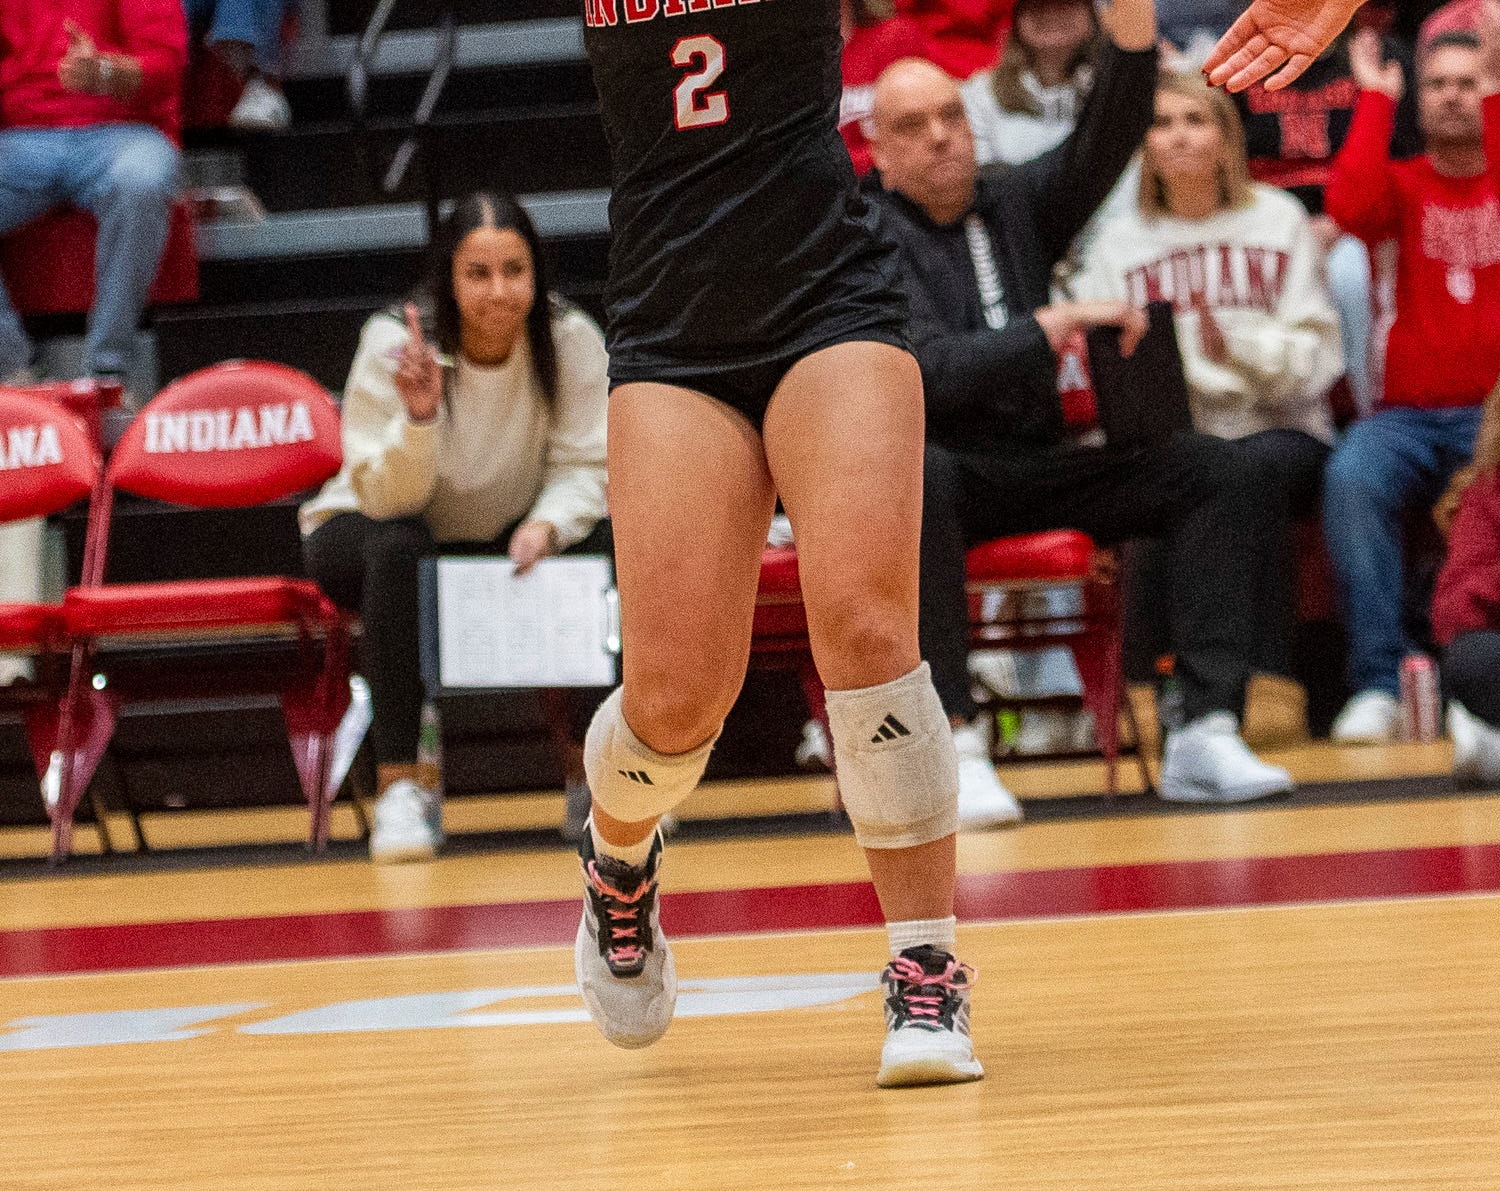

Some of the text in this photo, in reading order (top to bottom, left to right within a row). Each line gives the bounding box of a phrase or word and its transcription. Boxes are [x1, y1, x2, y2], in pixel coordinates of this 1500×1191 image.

[670, 32, 730, 132] 2
[0, 423, 63, 471] NA
[143, 401, 315, 454] INDIANA
